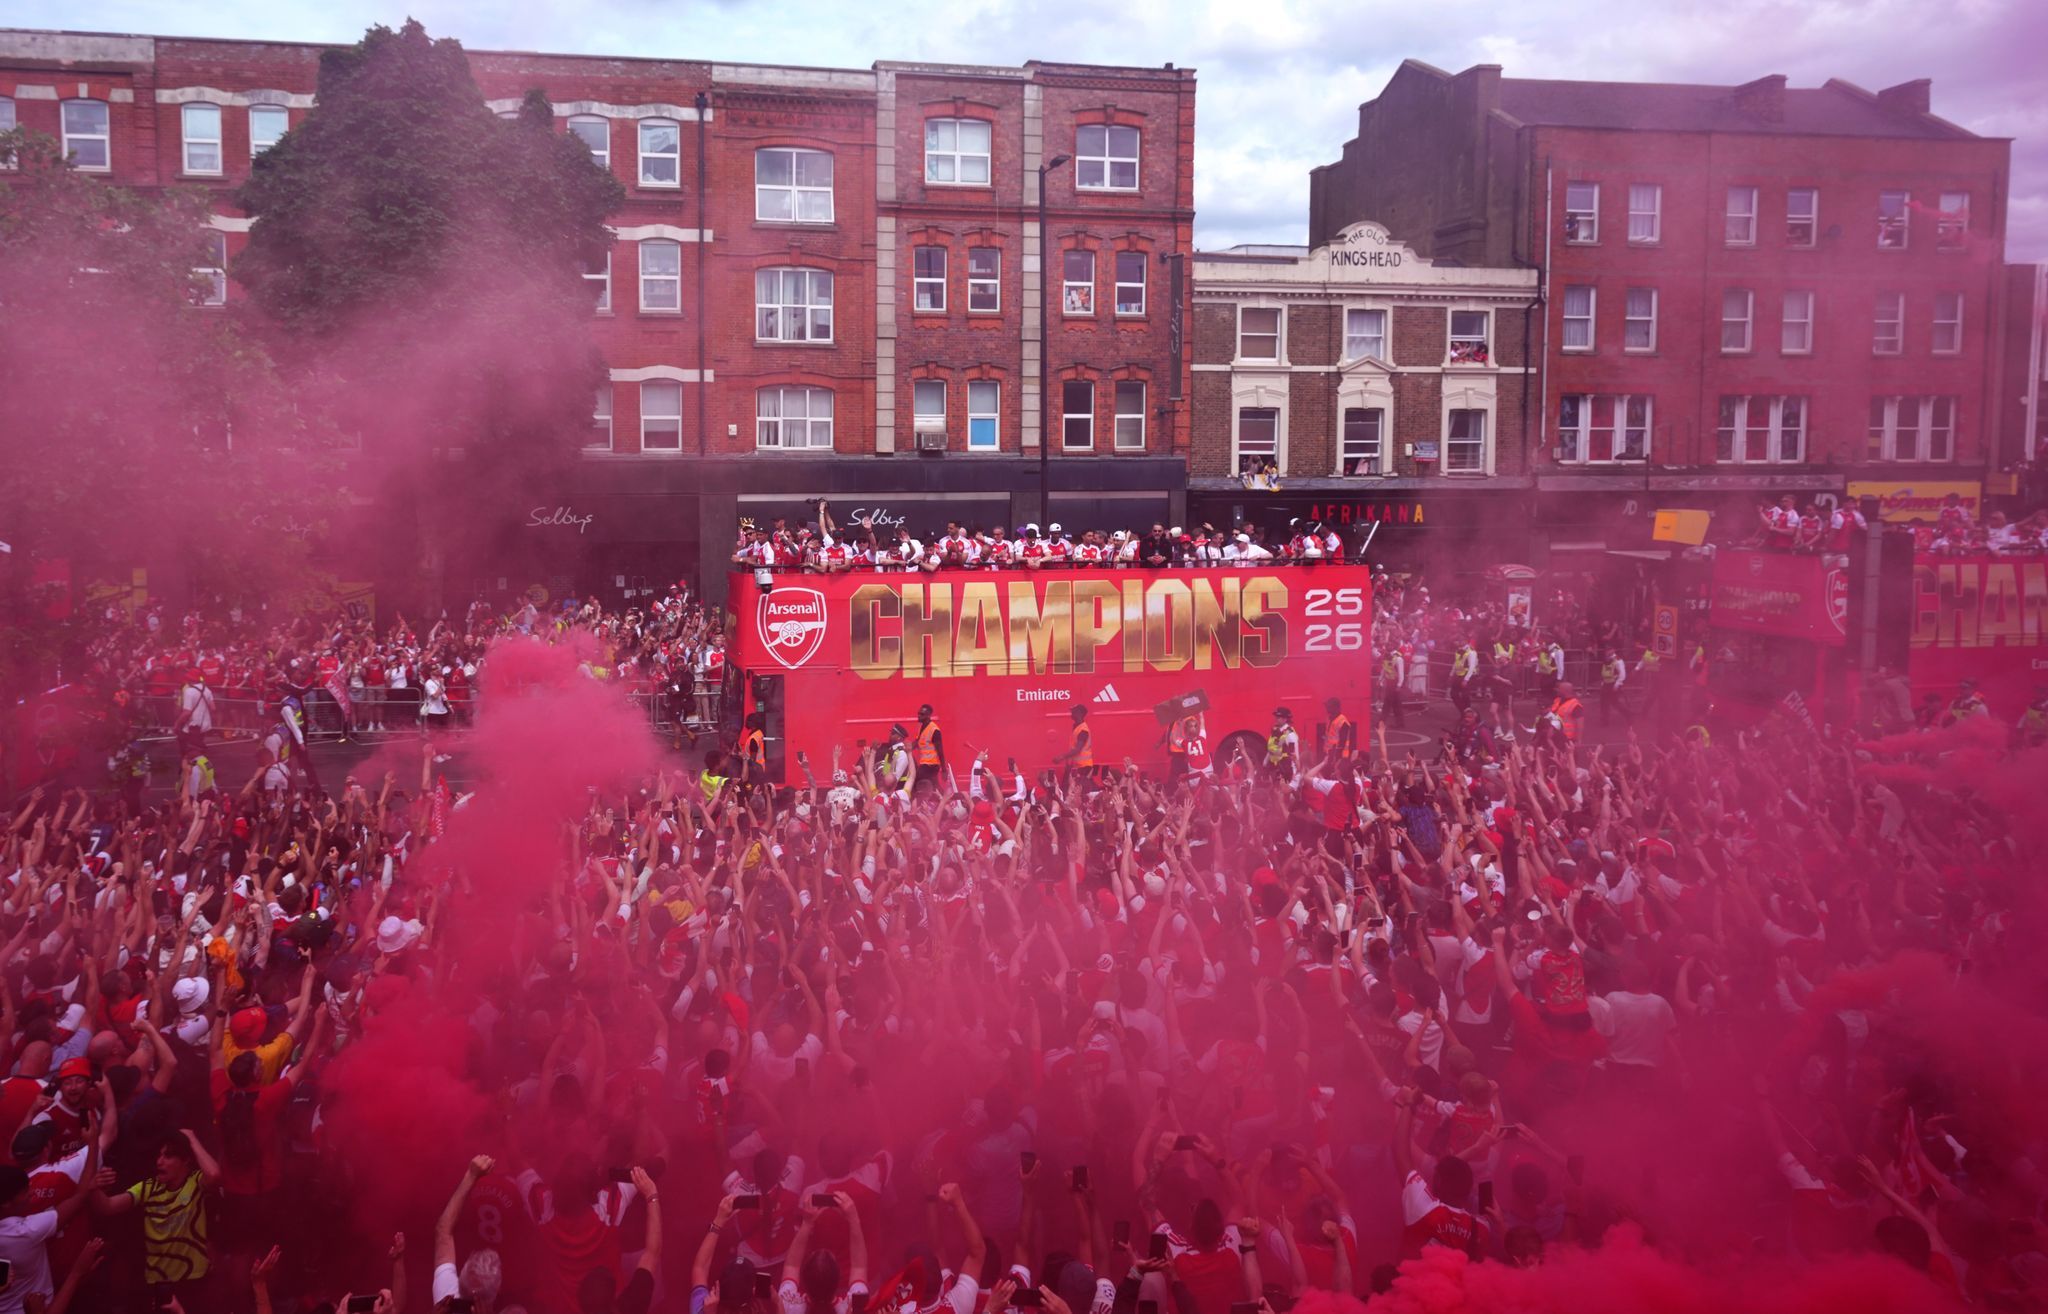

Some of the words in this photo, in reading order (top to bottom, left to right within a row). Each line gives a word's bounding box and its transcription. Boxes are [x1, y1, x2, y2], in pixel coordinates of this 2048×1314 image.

[1347, 229, 1365, 245] THE
[1366, 228, 1385, 246] OLD
[1369, 251, 1402, 268] HEAD
[525, 506, 593, 534] Selbys
[1311, 503, 1424, 524] AFRIKANA
[768, 602, 817, 615] Arsenal
[1305, 588, 1363, 616] 25
[850, 576, 1289, 679] CHAMPIONS
[1305, 623, 1363, 651] 26
[1016, 688, 1071, 701] Emirates
[1187, 739, 1205, 757] 41
